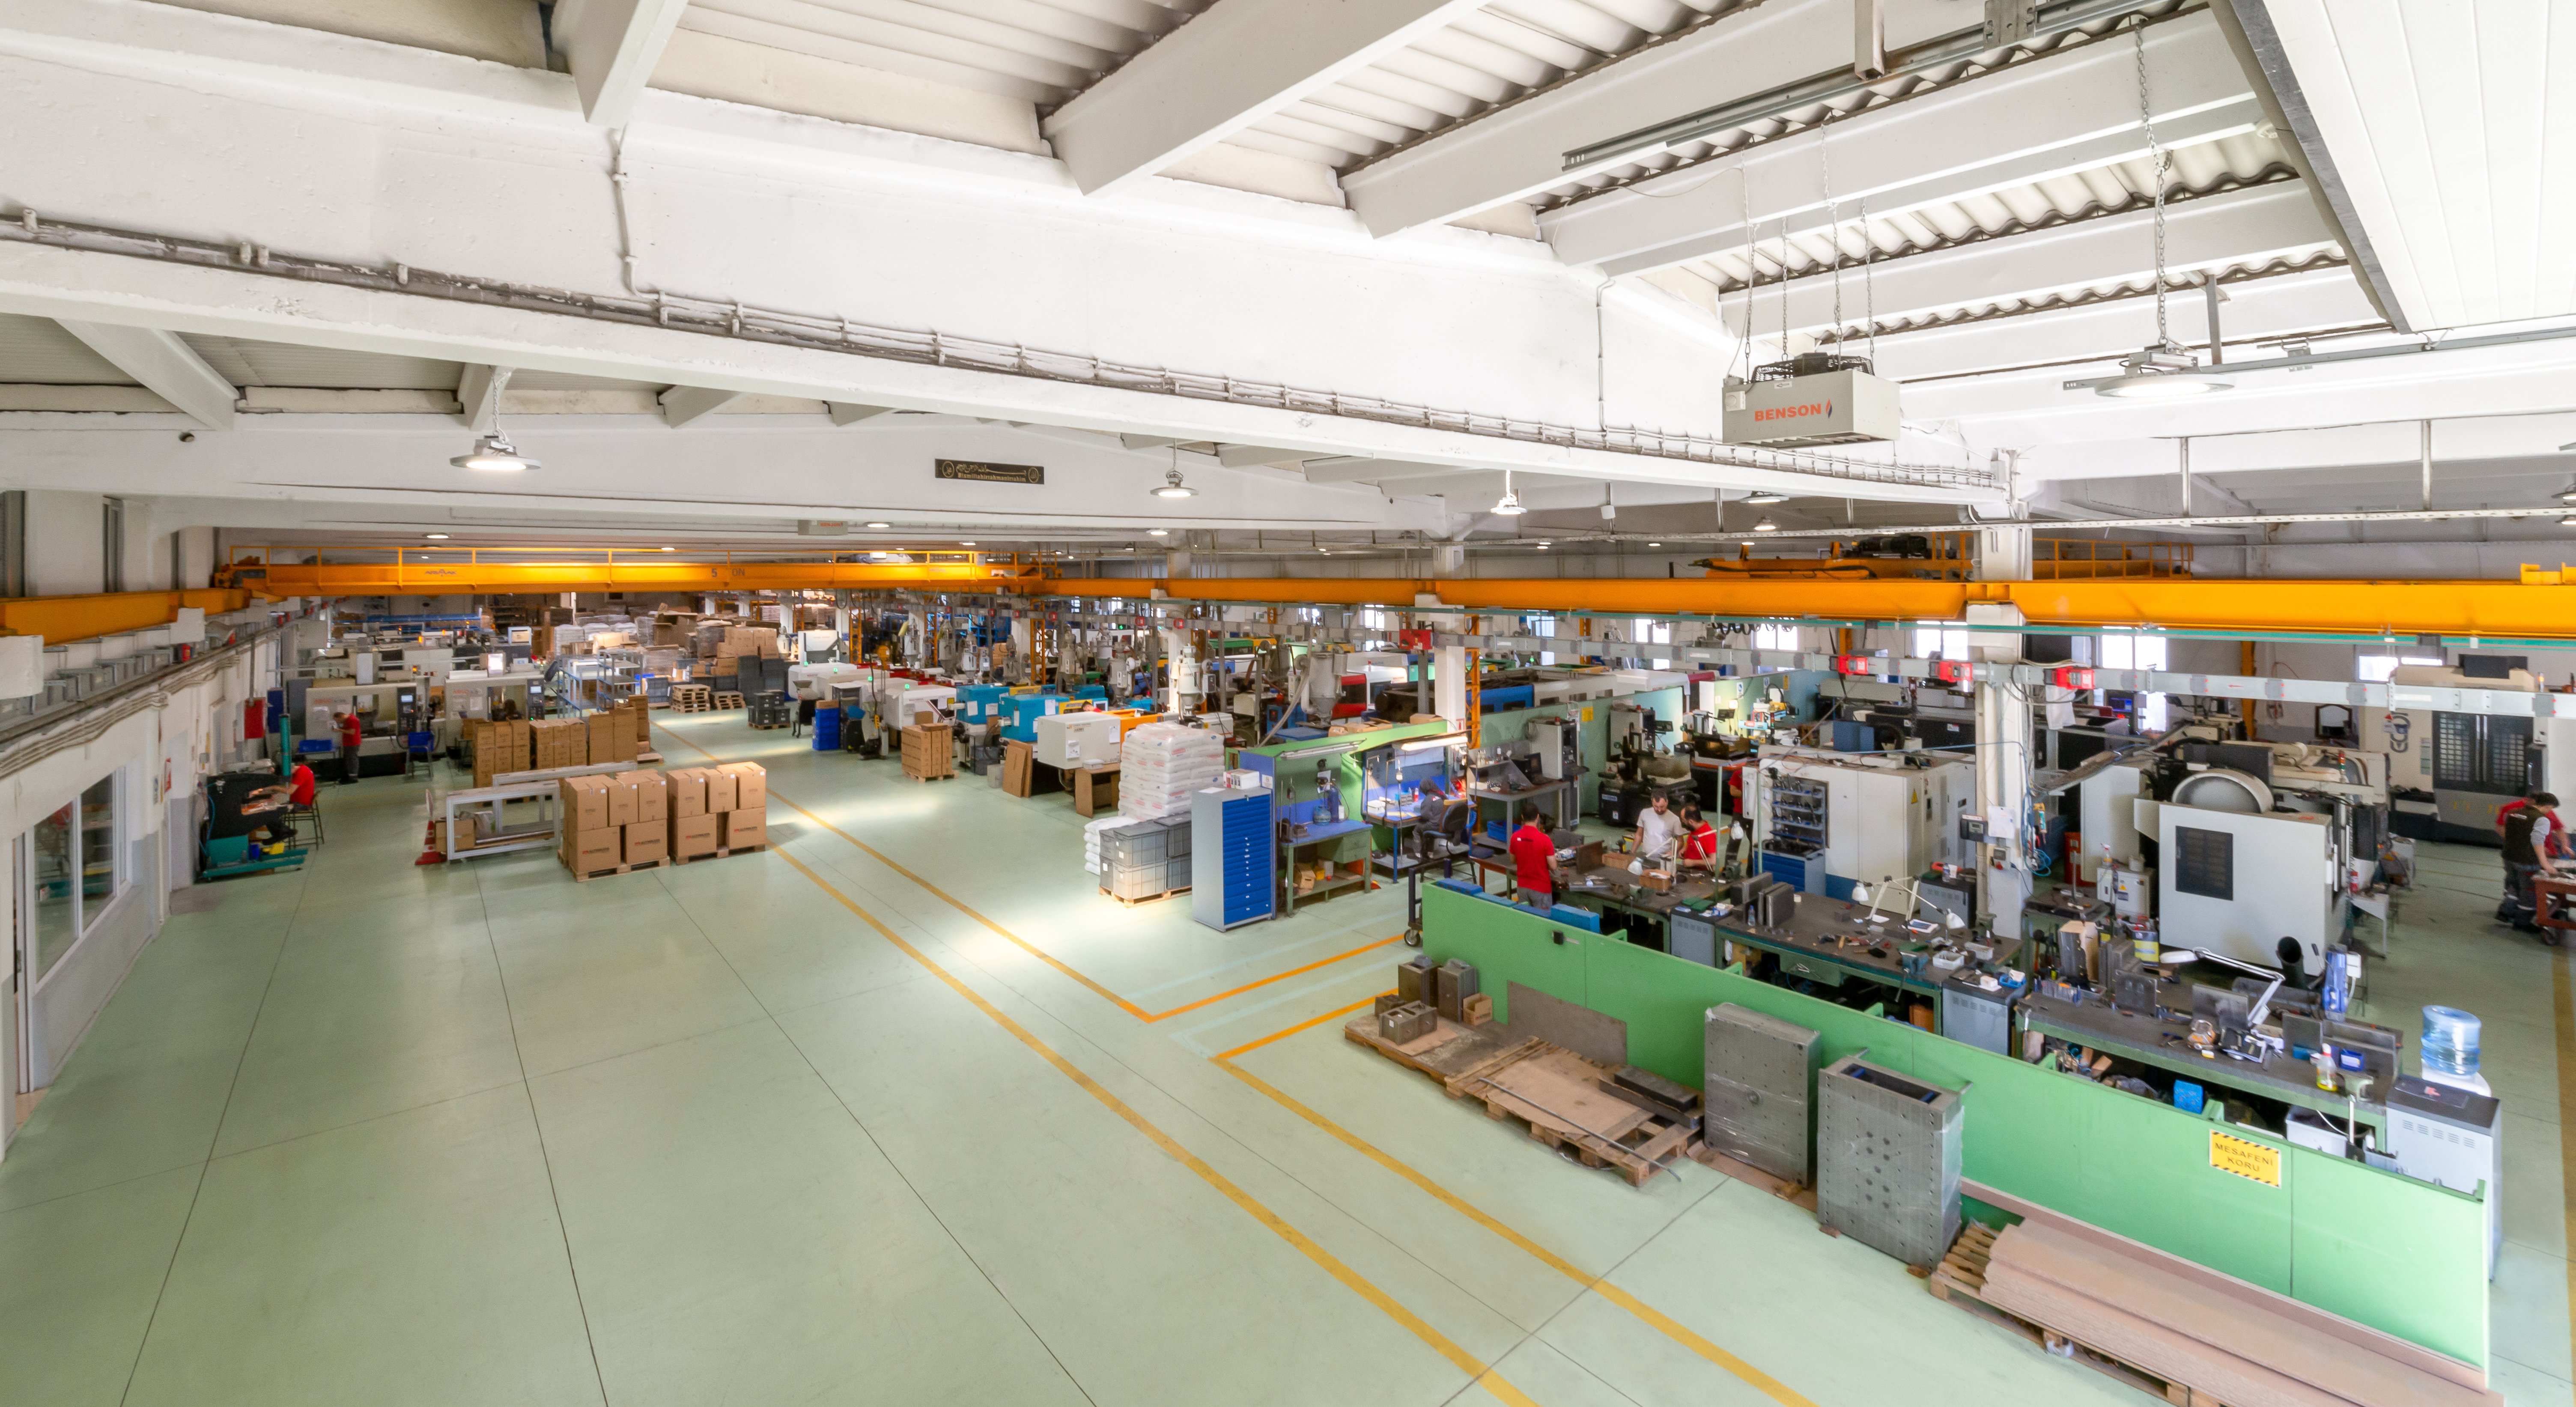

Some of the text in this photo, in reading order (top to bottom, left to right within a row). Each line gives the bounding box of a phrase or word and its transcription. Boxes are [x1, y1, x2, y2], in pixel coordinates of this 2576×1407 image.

[1755, 403, 1822, 421] BENSON
[712, 568, 745, 578] 5 ON
[2227, 1156, 2260, 1172] KORU
